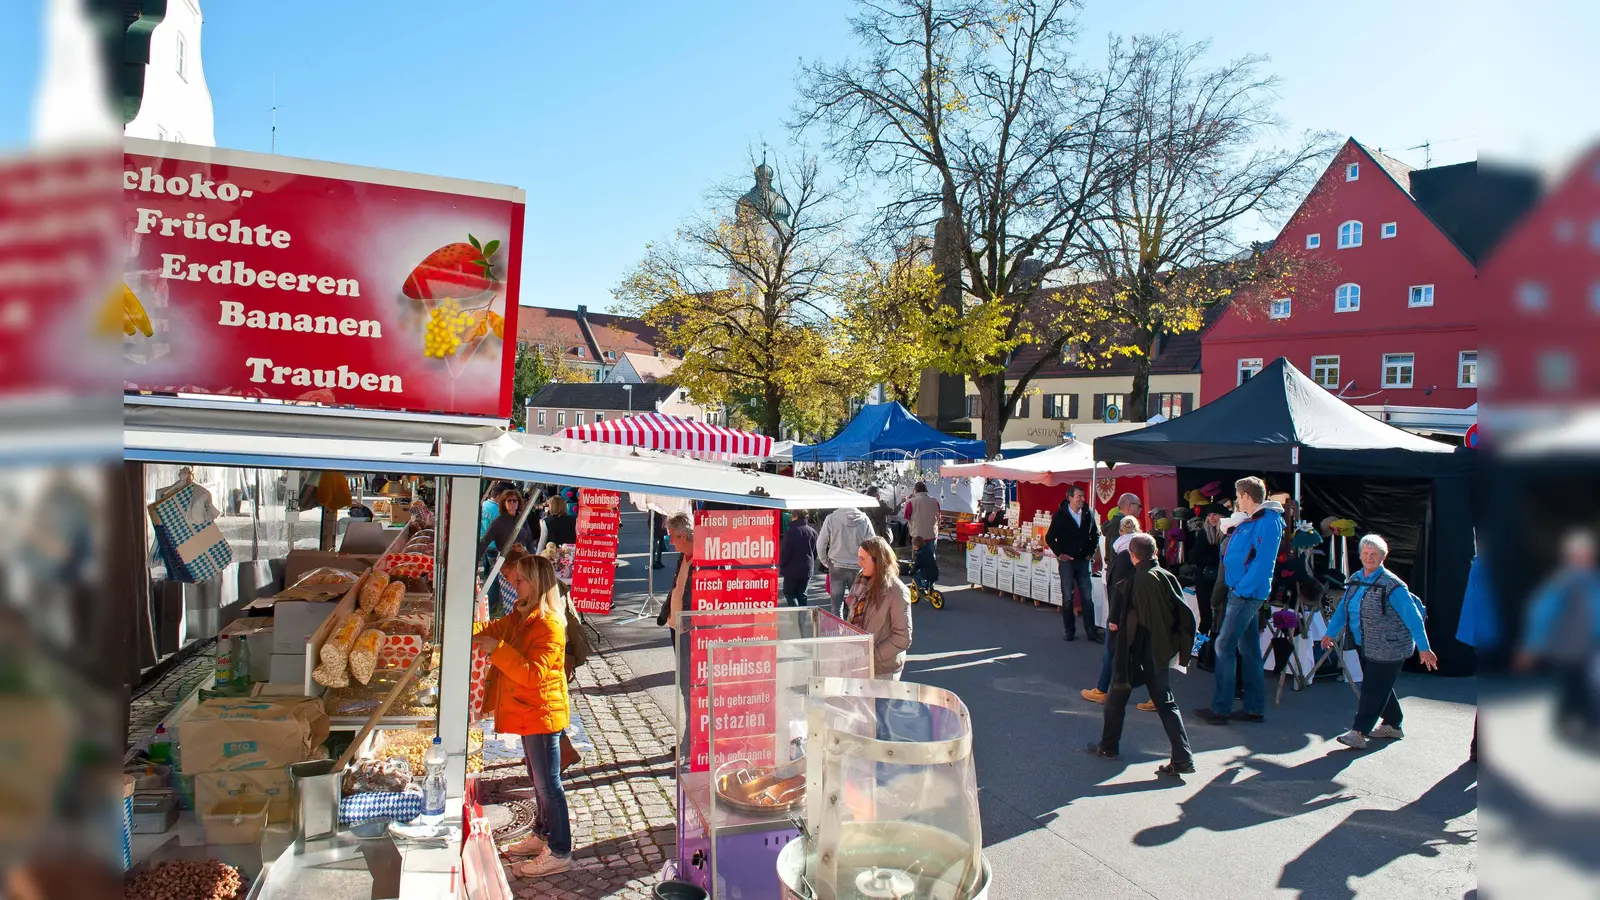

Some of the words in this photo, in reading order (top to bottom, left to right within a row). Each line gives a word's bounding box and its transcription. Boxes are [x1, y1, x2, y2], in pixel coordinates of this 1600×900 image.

[135, 207, 291, 249] Früchte
[160, 253, 360, 297] Erdbeeren
[219, 300, 383, 339] Bananen
[246, 357, 404, 393] Trauben
[1027, 428, 1062, 437] GASTHAU
[582, 493, 619, 505] Walnüsse
[580, 520, 614, 531] Magenbrot
[700, 515, 728, 527] frisch
[732, 514, 775, 529] gebrannte
[575, 547, 615, 559] Kürbiskerne
[705, 535, 775, 560] Mandeln
[587, 576, 609, 585] watte
[695, 578, 723, 591] frisch
[726, 577, 769, 592] gebrannte
[573, 596, 610, 611] Erdnüsse
[697, 597, 775, 616] Pekannüsse
[697, 659, 771, 679] Hselnüsse
[697, 695, 725, 709] frich
[727, 692, 770, 708] gebrannte
[700, 711, 766, 732] Pstazien
[697, 751, 725, 766] frich
[727, 748, 772, 763] gebrannte
